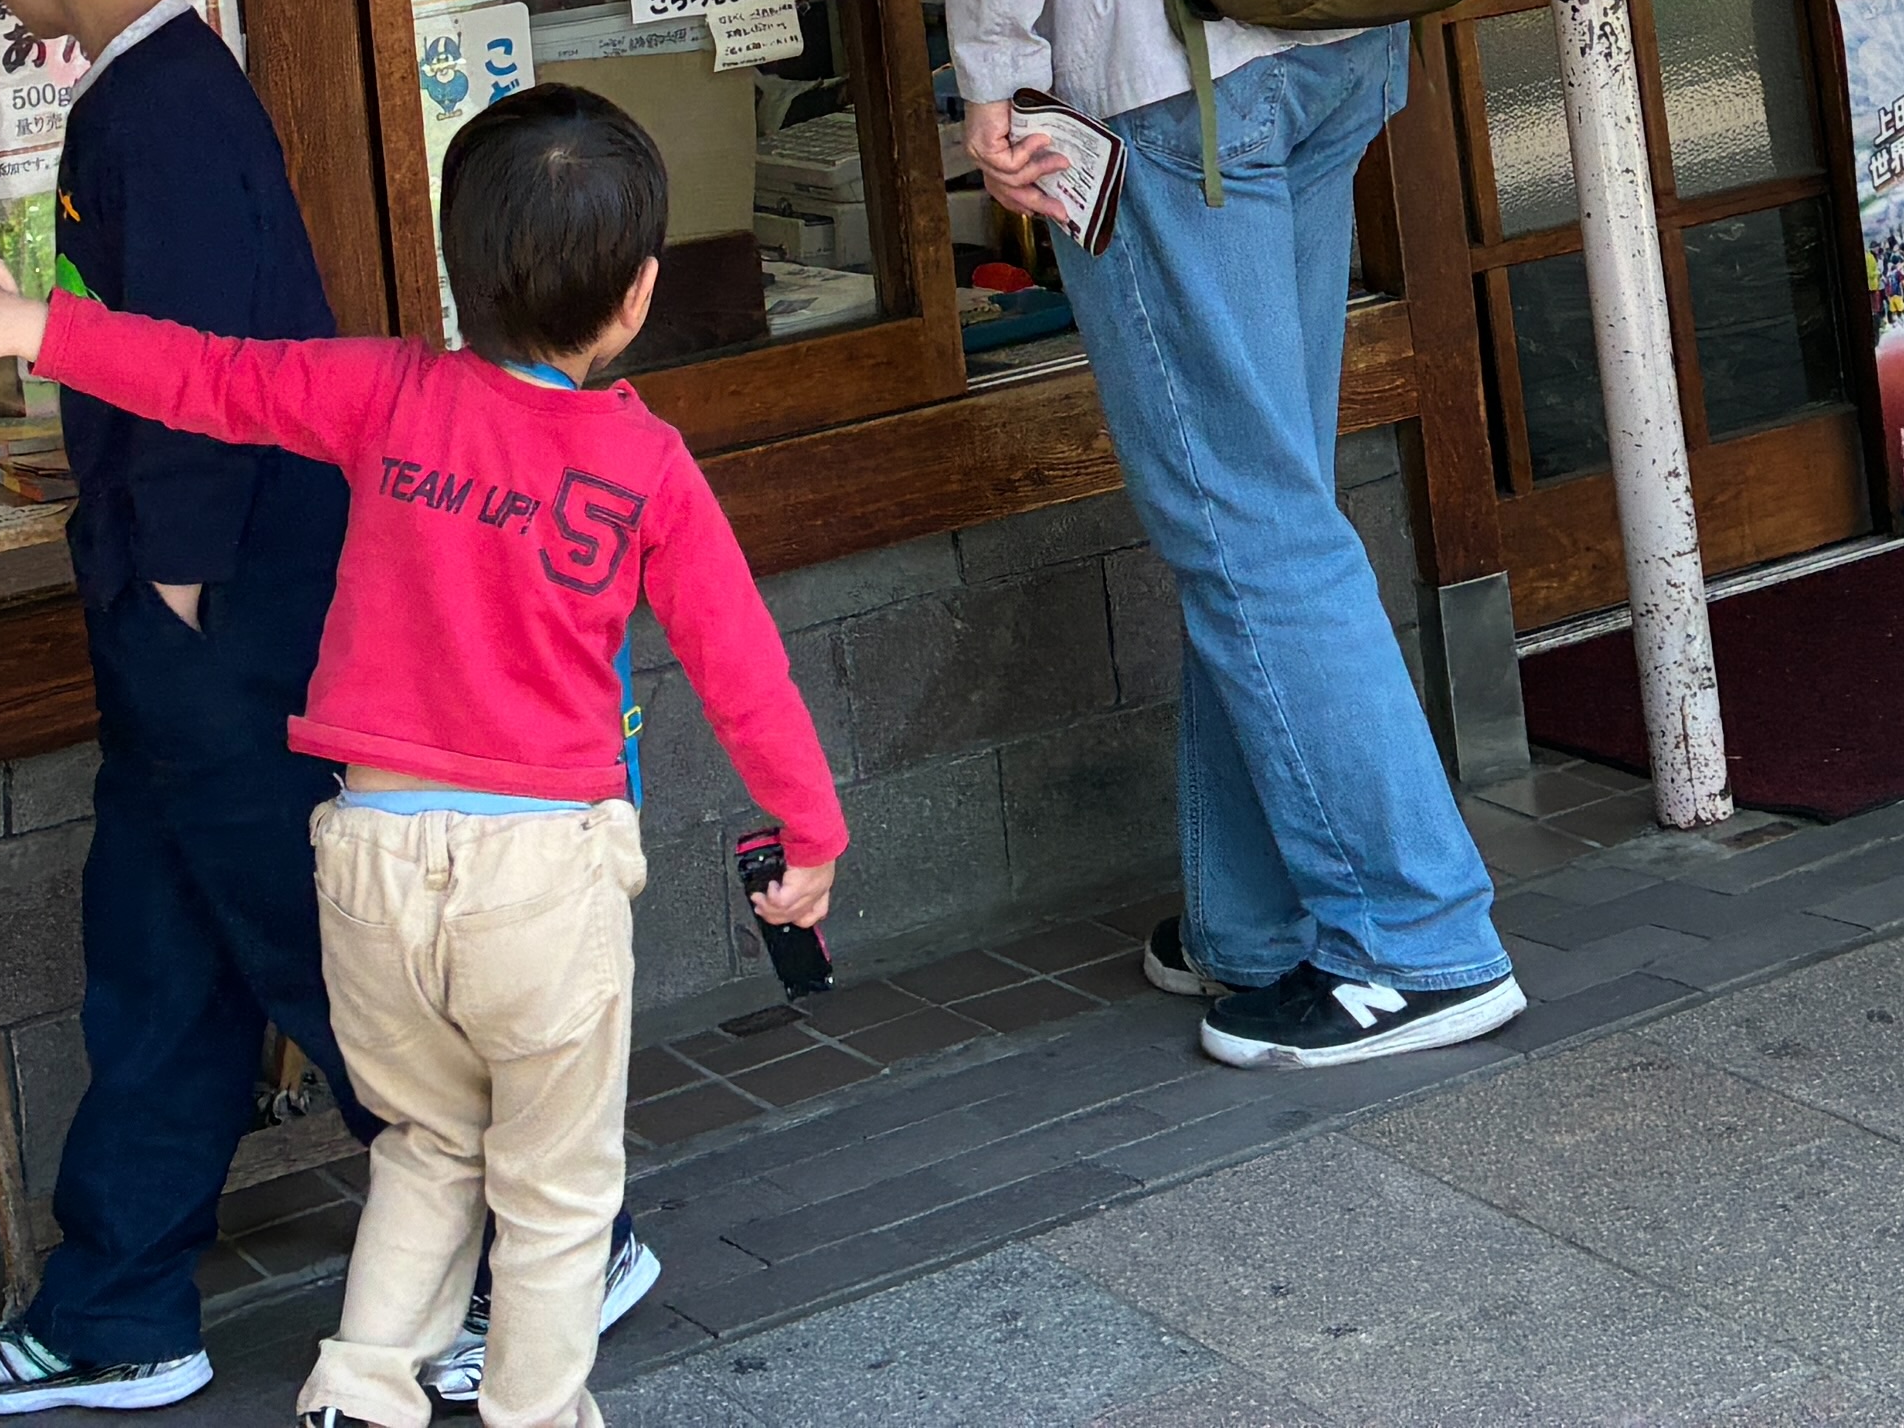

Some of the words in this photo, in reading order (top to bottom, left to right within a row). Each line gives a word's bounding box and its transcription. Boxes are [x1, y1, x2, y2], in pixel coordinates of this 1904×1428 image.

[12, 82, 73, 111] 500g
[380, 456, 474, 515] TEAM
[479, 484, 542, 536] UP!
[539, 466, 649, 597] 5
